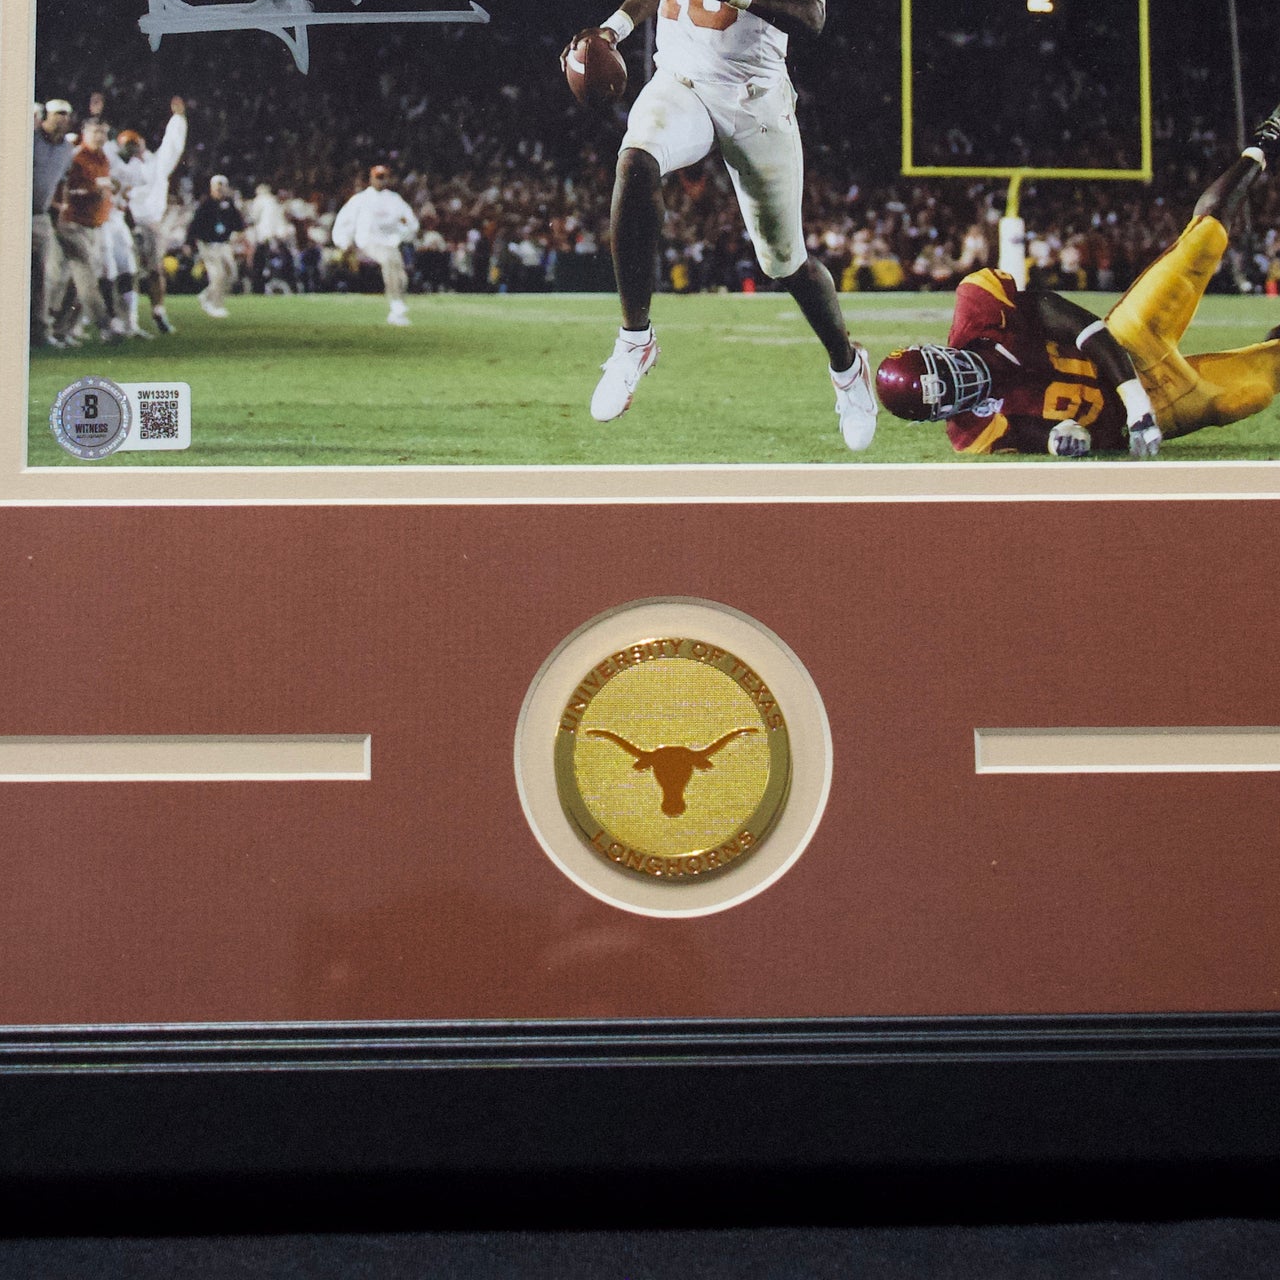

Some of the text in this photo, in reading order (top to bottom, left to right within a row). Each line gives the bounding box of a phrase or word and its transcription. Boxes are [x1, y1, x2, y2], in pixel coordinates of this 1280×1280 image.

[75, 423, 108, 433] WITNESS
[559, 638, 785, 733] UNIVERSITY OF TEXAS
[590, 828, 758, 877] LONGHORNS
